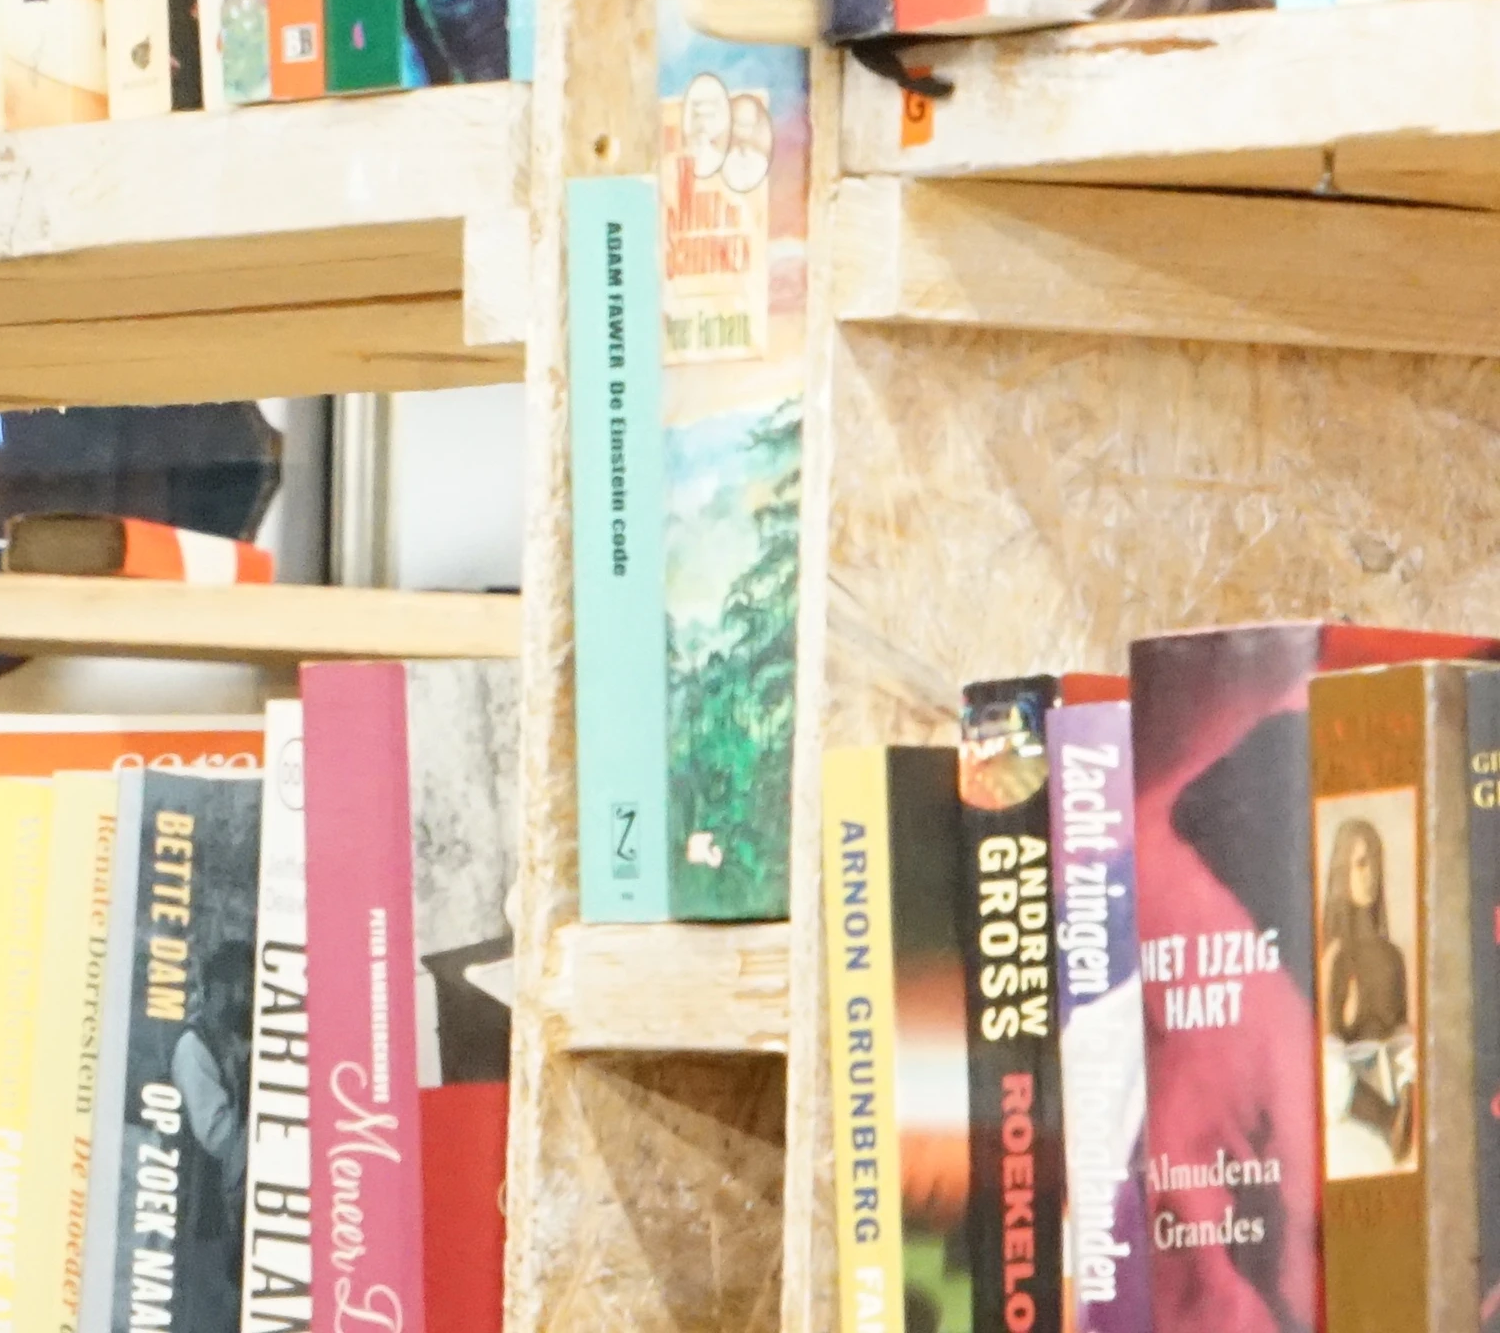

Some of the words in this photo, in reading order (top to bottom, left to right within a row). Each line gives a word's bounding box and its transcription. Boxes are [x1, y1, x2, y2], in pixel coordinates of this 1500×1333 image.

[607, 223, 623, 286] ADAM
[608, 294, 627, 368] FAWER
[610, 381, 627, 409] De
[611, 417, 627, 510] Einstein
[613, 518, 627, 577] code
[150, 811, 194, 928] BETTE
[841, 820, 871, 971] ARNON
[979, 835, 1019, 1043] GROSS
[1018, 835, 1047, 1039] ANDREW
[147, 940, 188, 1021] DAM
[1166, 984, 1243, 1031] HART
[140, 1082, 182, 1133] OP
[847, 997, 879, 1244] GRUNBERG
[133, 1146, 179, 1236] ZOEK
[1153, 1214, 1265, 1251] Grandes
